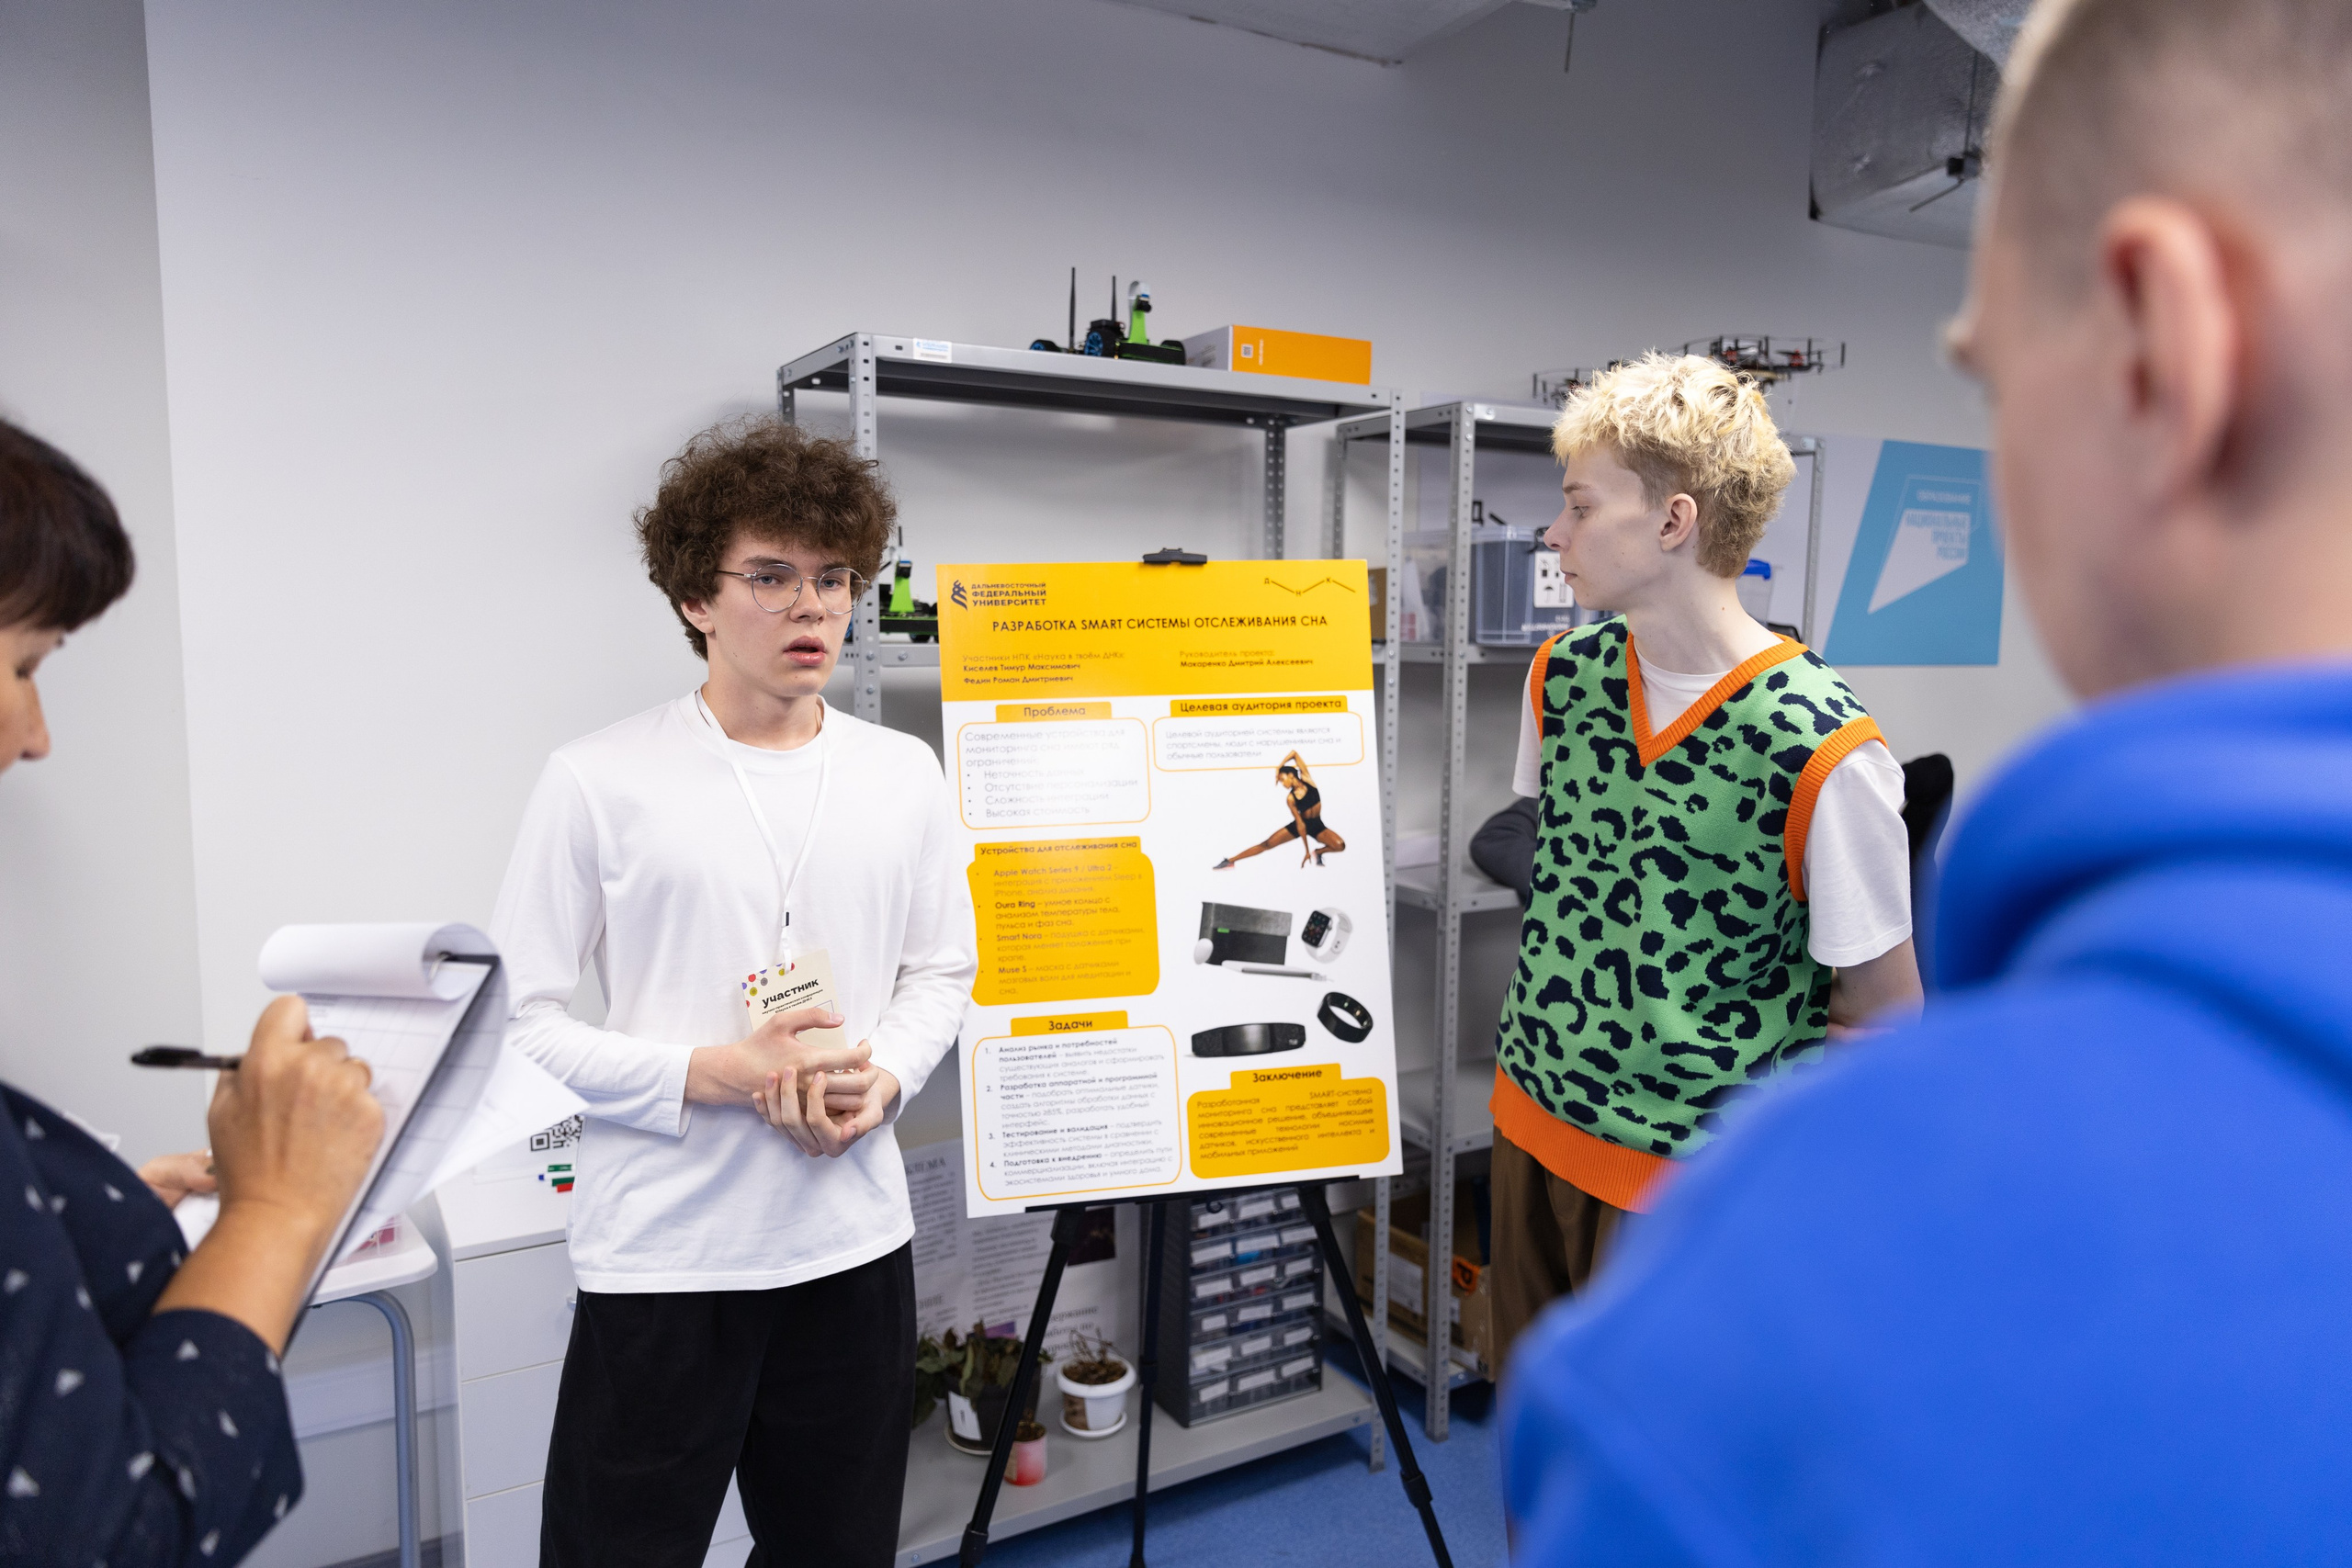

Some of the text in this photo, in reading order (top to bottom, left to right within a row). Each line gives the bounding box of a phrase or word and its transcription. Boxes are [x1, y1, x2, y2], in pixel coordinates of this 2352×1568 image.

[972, 598, 1046, 606] УНИВЕРСИТЕТ
[992, 615, 1329, 632] РАЗРАБОТКА SMART СИСТЕМЫ ОТСЛЕЖИВАНИЯ СНА
[1000, 663, 1025, 672] Тимур
[1027, 662, 1080, 671] Максимович
[1180, 660, 1226, 669] Макаренко
[1227, 659, 1263, 668] Дмитрий
[964, 675, 1073, 685] Федин Роман Дмитриевич
[1023, 706, 1086, 719] Проблема
[1180, 701, 1341, 715] Целевая аудитория проекта
[965, 731, 1043, 743] Современные
[984, 770, 1044, 779] Неточность
[985, 795, 1045, 805] Сложность
[986, 808, 1031, 818] Высокая
[980, 845, 1035, 856] Устройства
[1036, 845, 1052, 854] для
[1054, 842, 1118, 852] отслеживания
[994, 867, 1018, 879] Apple
[1021, 866, 1046, 875] Watch
[1048, 865, 1071, 874] Series
[995, 901, 1015, 909] Oura
[1017, 899, 1035, 909] Ring
[996, 932, 1020, 942] Smart
[998, 965, 1020, 974] Muse
[762, 979, 819, 1009] участник
[1048, 1020, 1093, 1032] Задачи
[1061, 1037, 1118, 1049] потребностей
[1252, 1070, 1323, 1082] Заключение
[1000, 1081, 1046, 1091] Разработка
[1196, 1097, 1261, 1109] Разработанная
[1002, 1128, 1057, 1138] Тестирование
[1003, 1157, 1049, 1168] Подготовка
